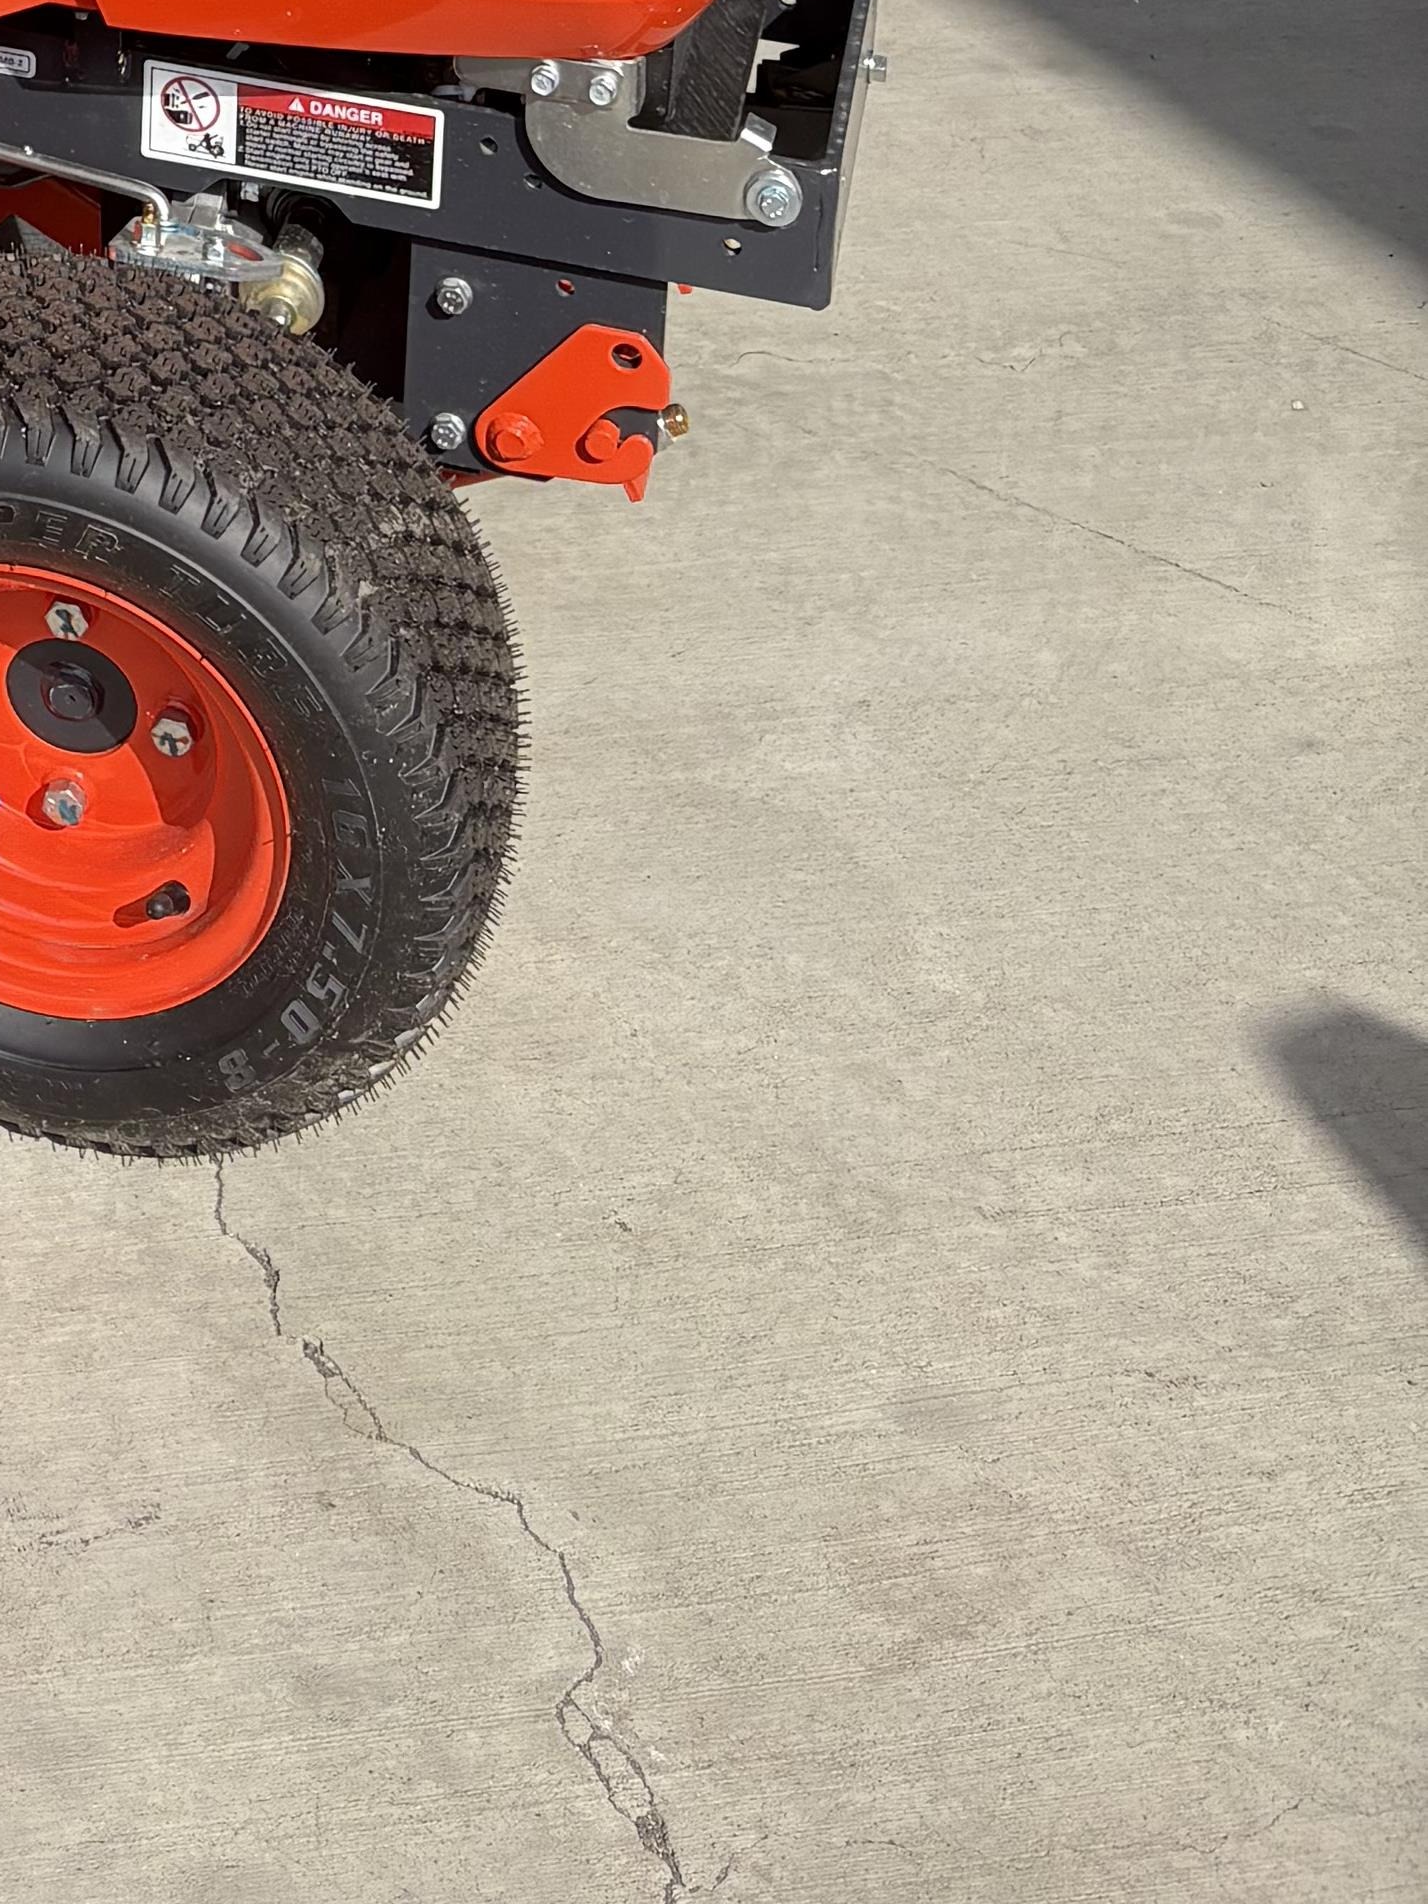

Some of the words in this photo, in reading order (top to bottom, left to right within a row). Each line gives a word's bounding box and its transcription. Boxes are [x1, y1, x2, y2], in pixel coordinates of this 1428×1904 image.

[239, 106, 252, 114] TO
[254, 108, 283, 120] AVOID
[286, 114, 334, 129] POSSIBLE
[337, 123, 371, 136] INJURY
[375, 130, 389, 139] OR
[392, 133, 425, 145] DEATH
[309, 99, 383, 126] DANGER
